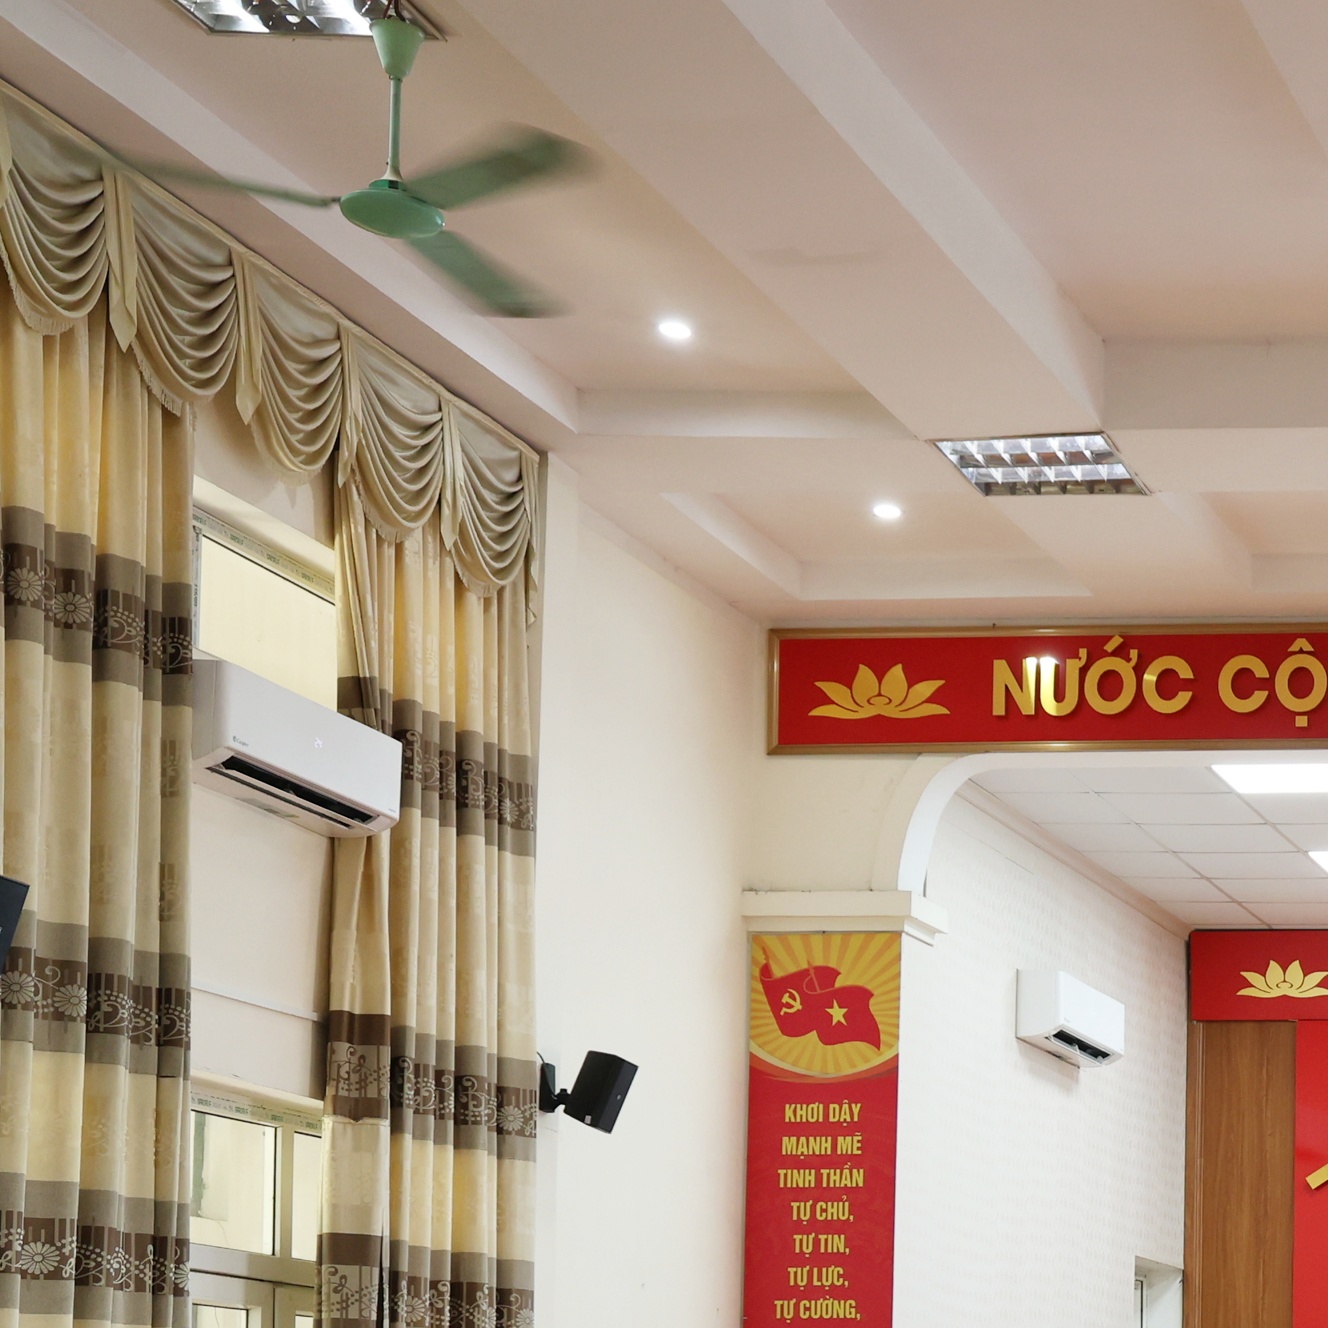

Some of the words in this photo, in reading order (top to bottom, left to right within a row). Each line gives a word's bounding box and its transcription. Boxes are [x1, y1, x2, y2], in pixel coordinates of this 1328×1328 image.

[991, 635, 1195, 717] NƯỚC
[785, 1102, 823, 1122] KHƠI
[829, 1100, 861, 1126] DẬY
[782, 1137, 831, 1159] MẠNH
[837, 1133, 862, 1154] MẼ
[778, 1169, 815, 1187] TINH
[821, 1163, 864, 1187] THẦN
[791, 1200, 812, 1224] TỰ
[816, 1196, 853, 1221] CHỦ,
[794, 1233, 815, 1257] TỰ
[819, 1235, 849, 1254] TIN,
[788, 1266, 809, 1290] TỰ
[813, 1266, 848, 1289] LỰC,
[775, 1299, 796, 1322] TỰ
[800, 1296, 860, 1320] CƯỜNG,
